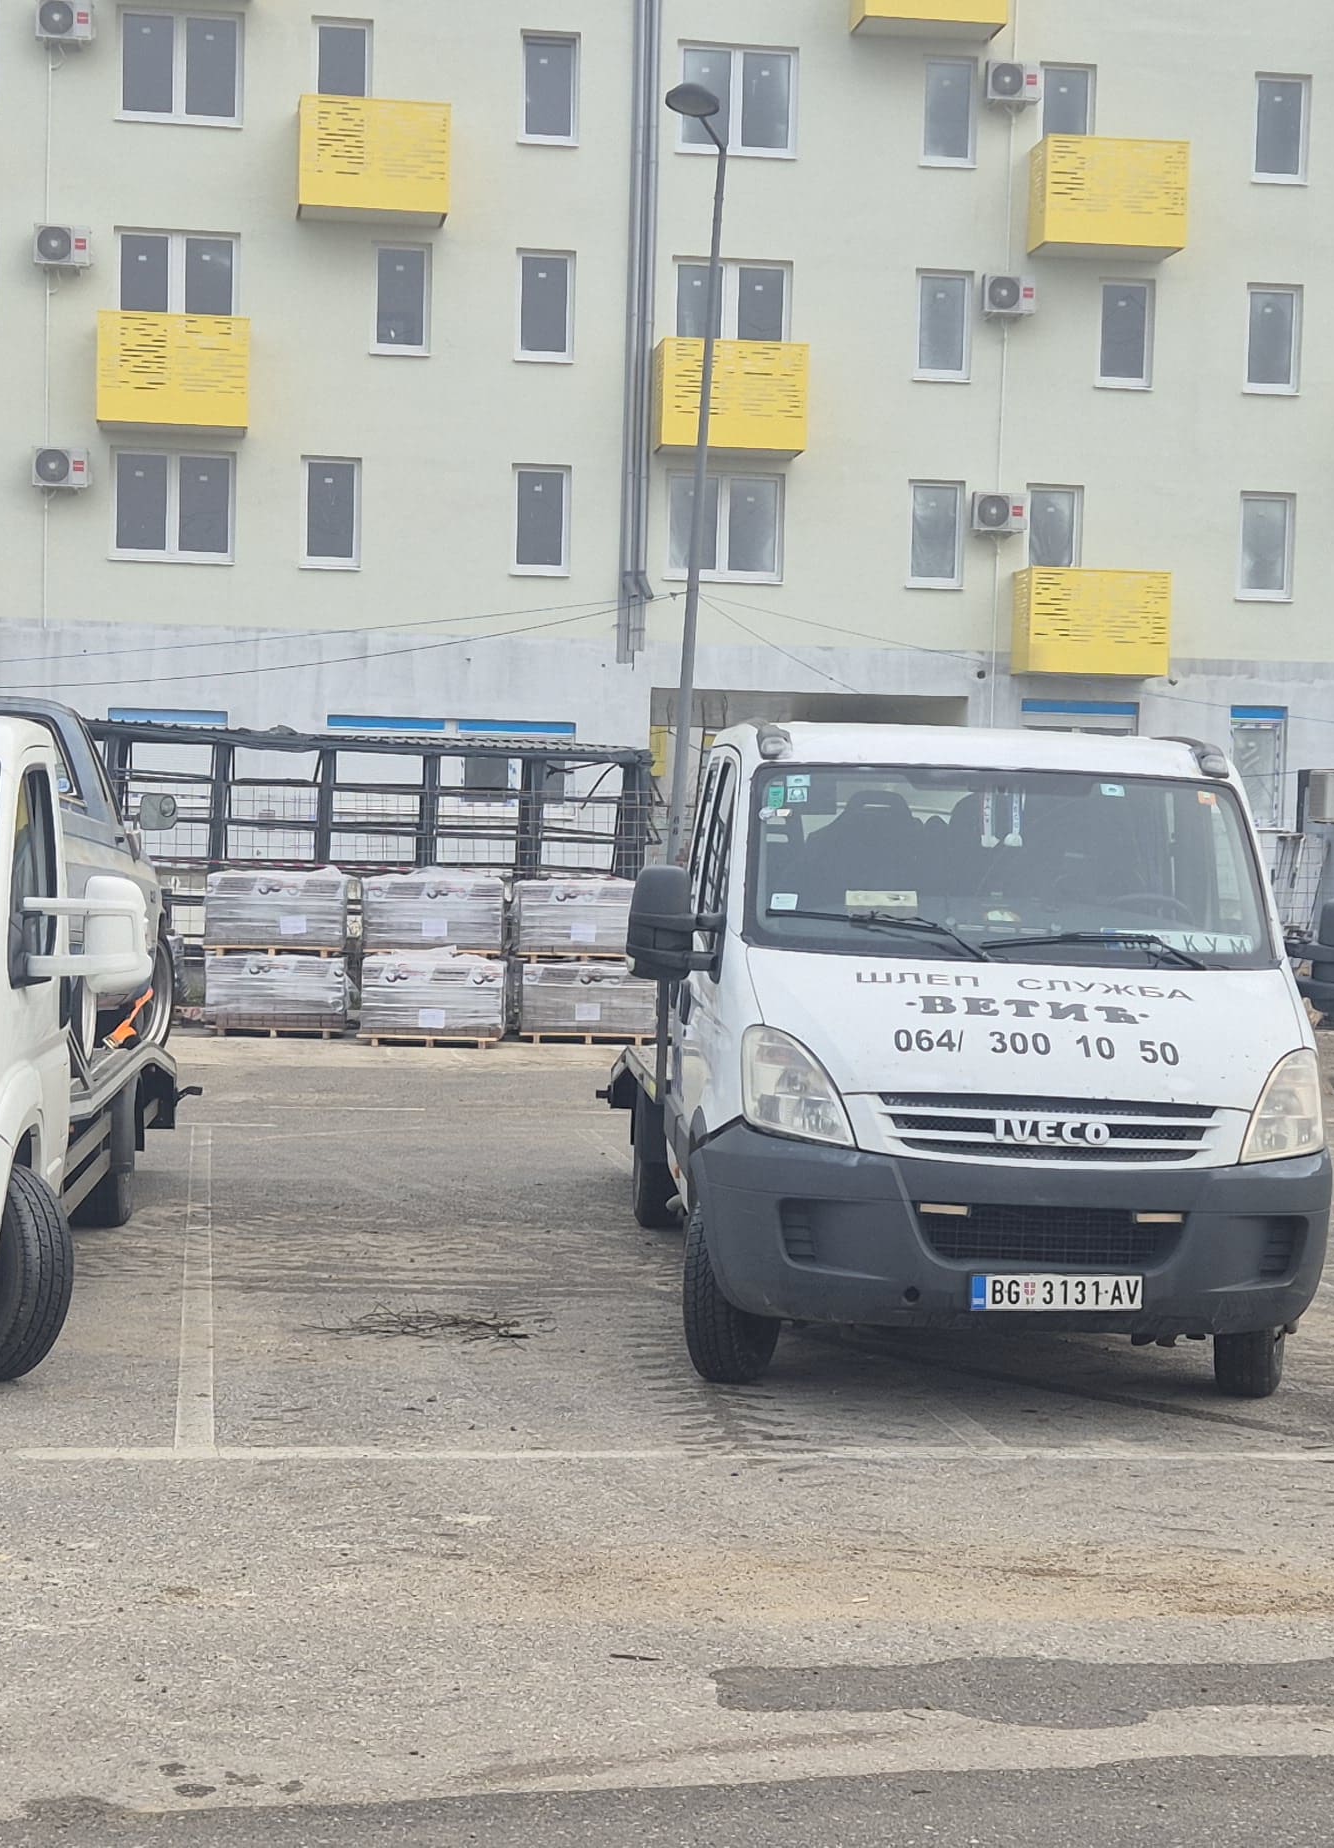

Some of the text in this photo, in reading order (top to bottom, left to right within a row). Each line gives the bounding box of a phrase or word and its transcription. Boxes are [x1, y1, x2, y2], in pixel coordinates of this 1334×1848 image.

[855, 972, 1195, 1001] ШЛЕП СЛУЖБА
[894, 1028, 1180, 1066] 064/ 300 10 50
[994, 1118, 1110, 1145] IVECO
[991, 1279, 1020, 1305] BG
